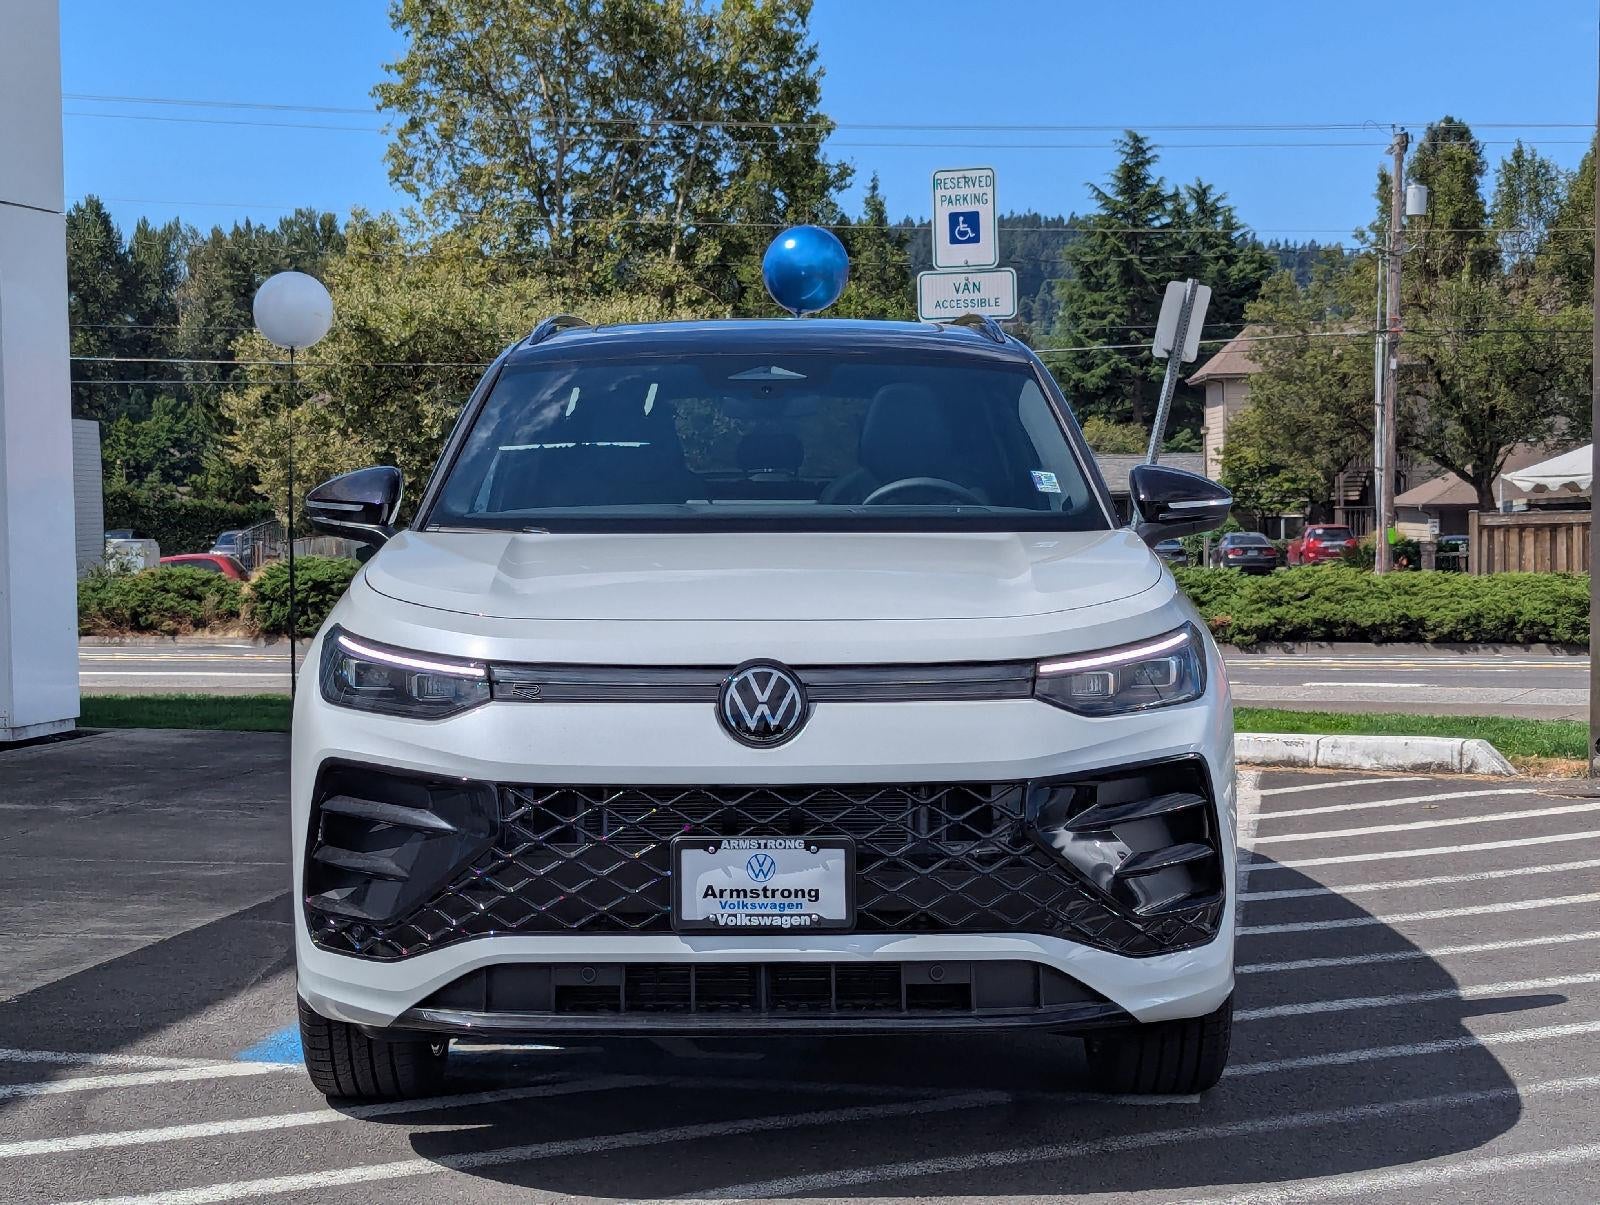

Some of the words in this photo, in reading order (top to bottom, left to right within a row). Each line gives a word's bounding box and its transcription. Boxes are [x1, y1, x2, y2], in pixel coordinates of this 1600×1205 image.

[935, 175, 992, 191] RESERVED
[940, 193, 989, 207] PARKING
[953, 281, 981, 295] VAN
[935, 297, 1000, 310] ACCESSIBLE
[720, 839, 805, 850] ARMSTRONG
[702, 884, 820, 902] Armstrong
[719, 900, 803, 912] Volkswagen
[715, 913, 811, 928] Volkswagen
